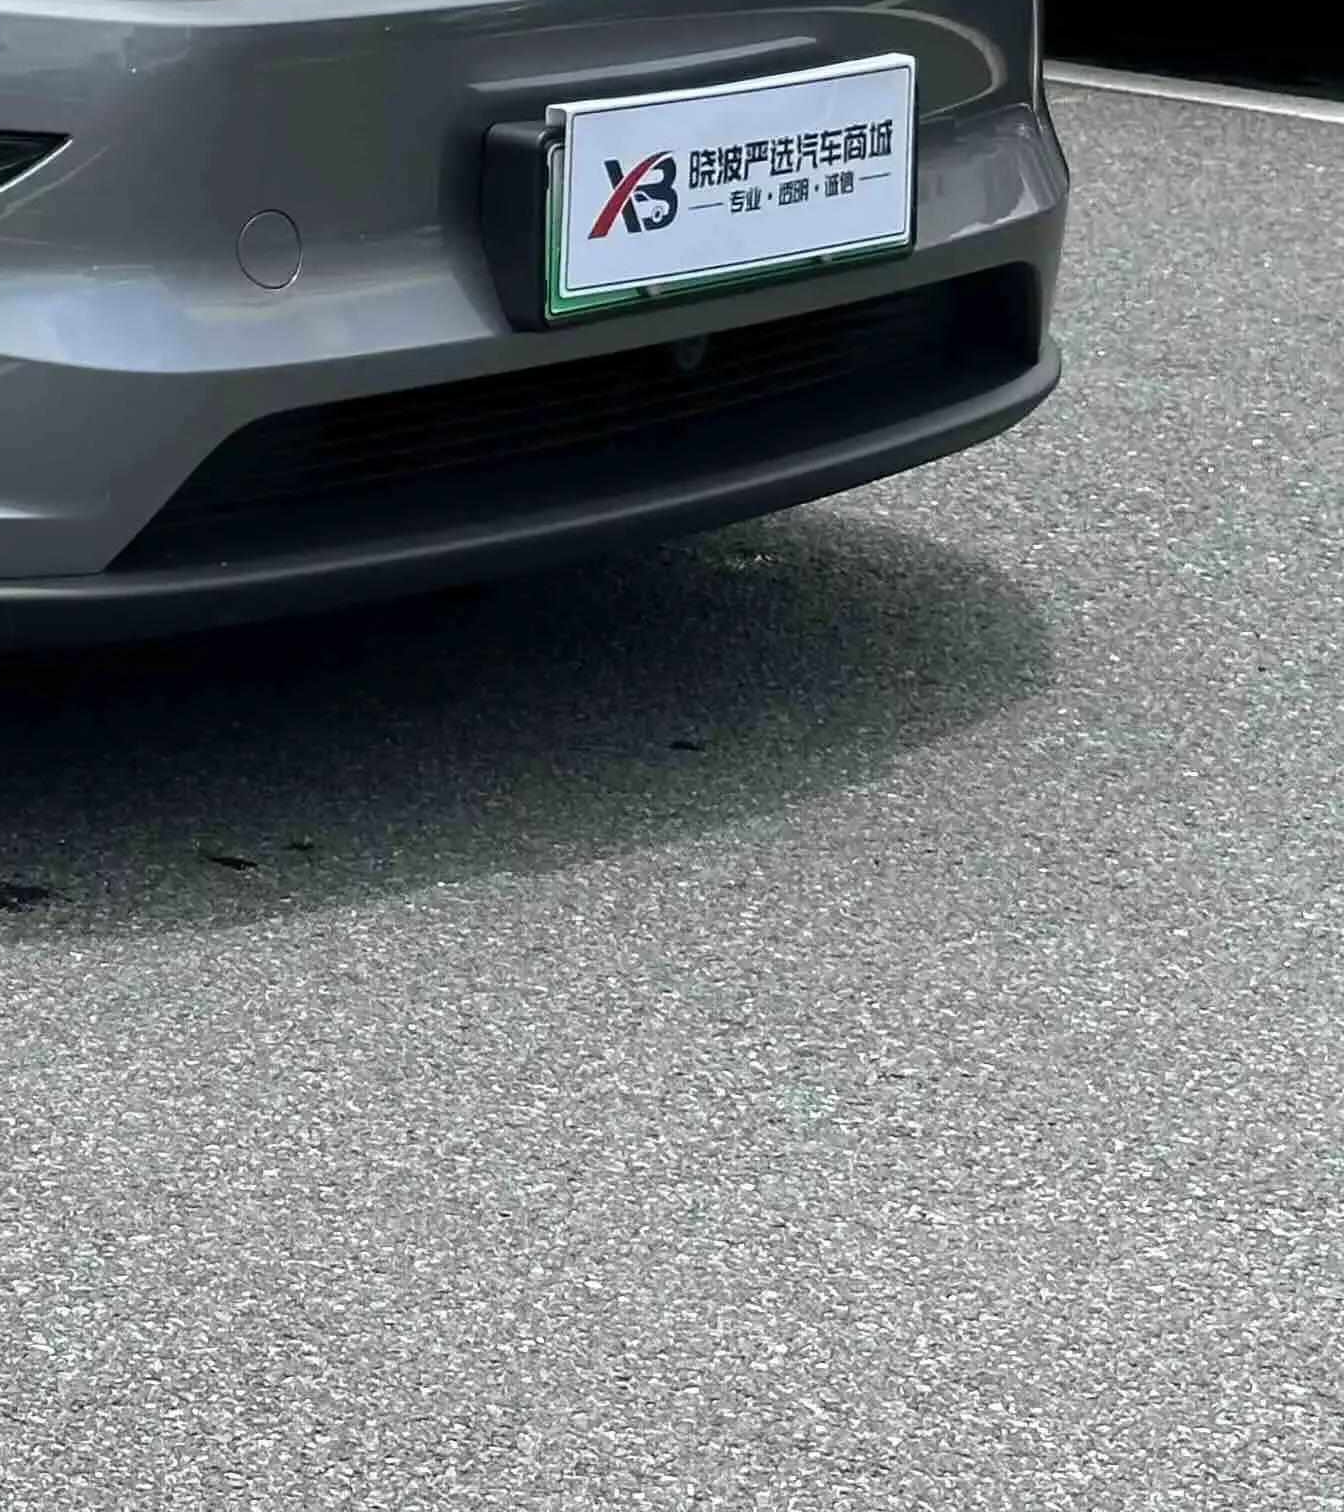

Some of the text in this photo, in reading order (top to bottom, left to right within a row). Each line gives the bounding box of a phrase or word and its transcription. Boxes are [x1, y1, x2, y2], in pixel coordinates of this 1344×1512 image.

[688, 119, 893, 189] 晓波严选汽车商城
